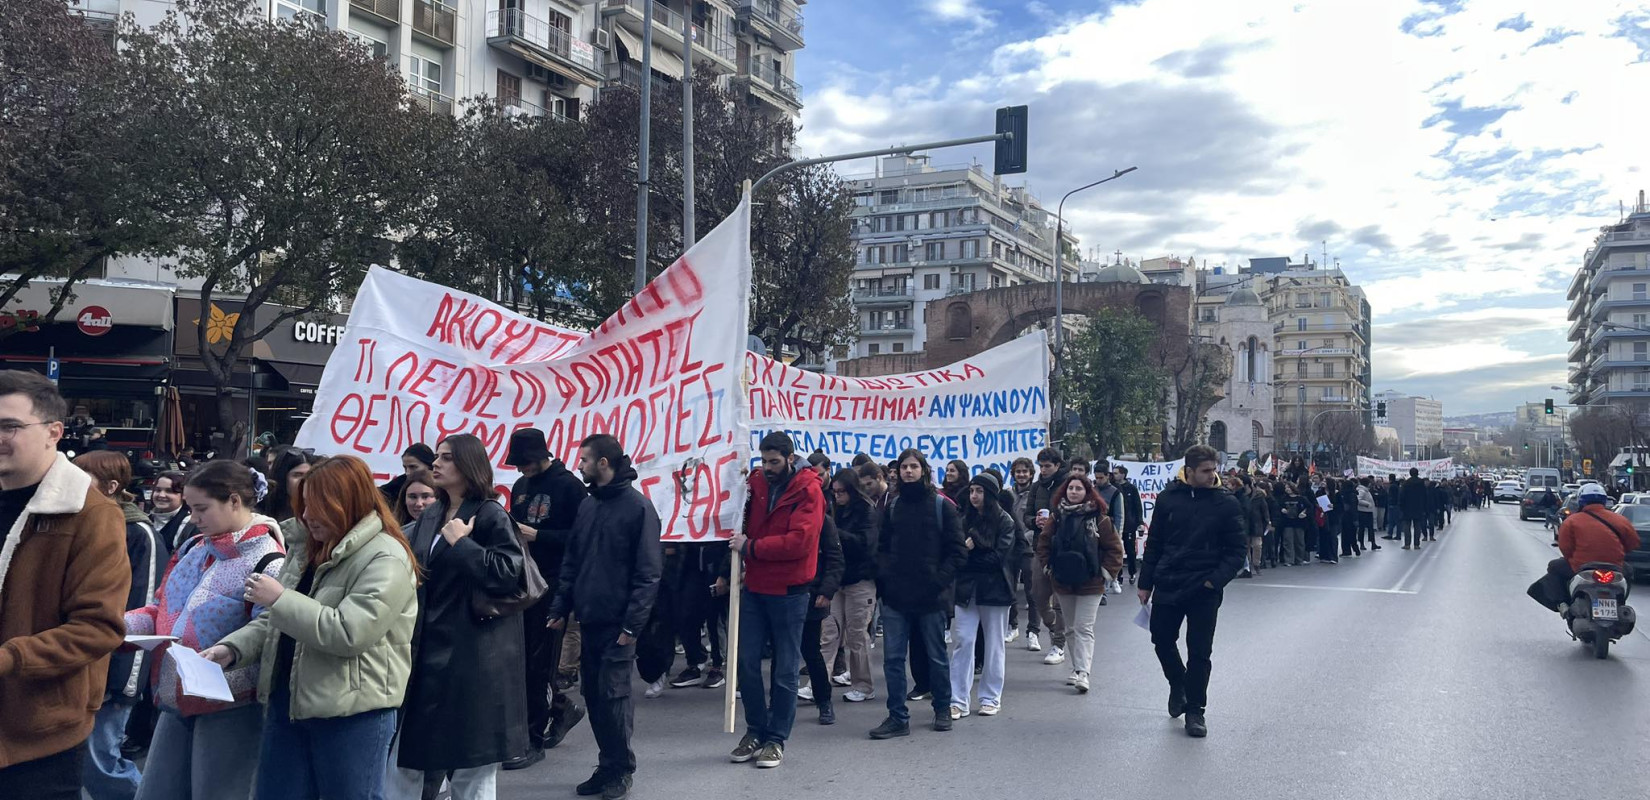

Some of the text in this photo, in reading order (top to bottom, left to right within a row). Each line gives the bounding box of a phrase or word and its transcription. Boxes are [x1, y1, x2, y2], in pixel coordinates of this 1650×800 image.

[79, 312, 112, 328] 4all
[427, 292, 584, 366] ΑΚΟΥΣΤ
[50, 360, 58, 376] P
[354, 339, 377, 383] ΤΙ
[511, 370, 546, 418] ΟΙ
[548, 306, 705, 413] ΦΟΙΤΗΤΕΣ
[750, 386, 1046, 421] ΠΑΝΕΠΙΣΤΗΜΙΑ! ΑΝ ΨΑΧΝΟΥΝ
[917, 434, 968, 460] ΕΧΕΙ
[973, 428, 1047, 458] ΦΟΙΤΗΤΕΣ
[1600, 609, 1617, 617] 175
